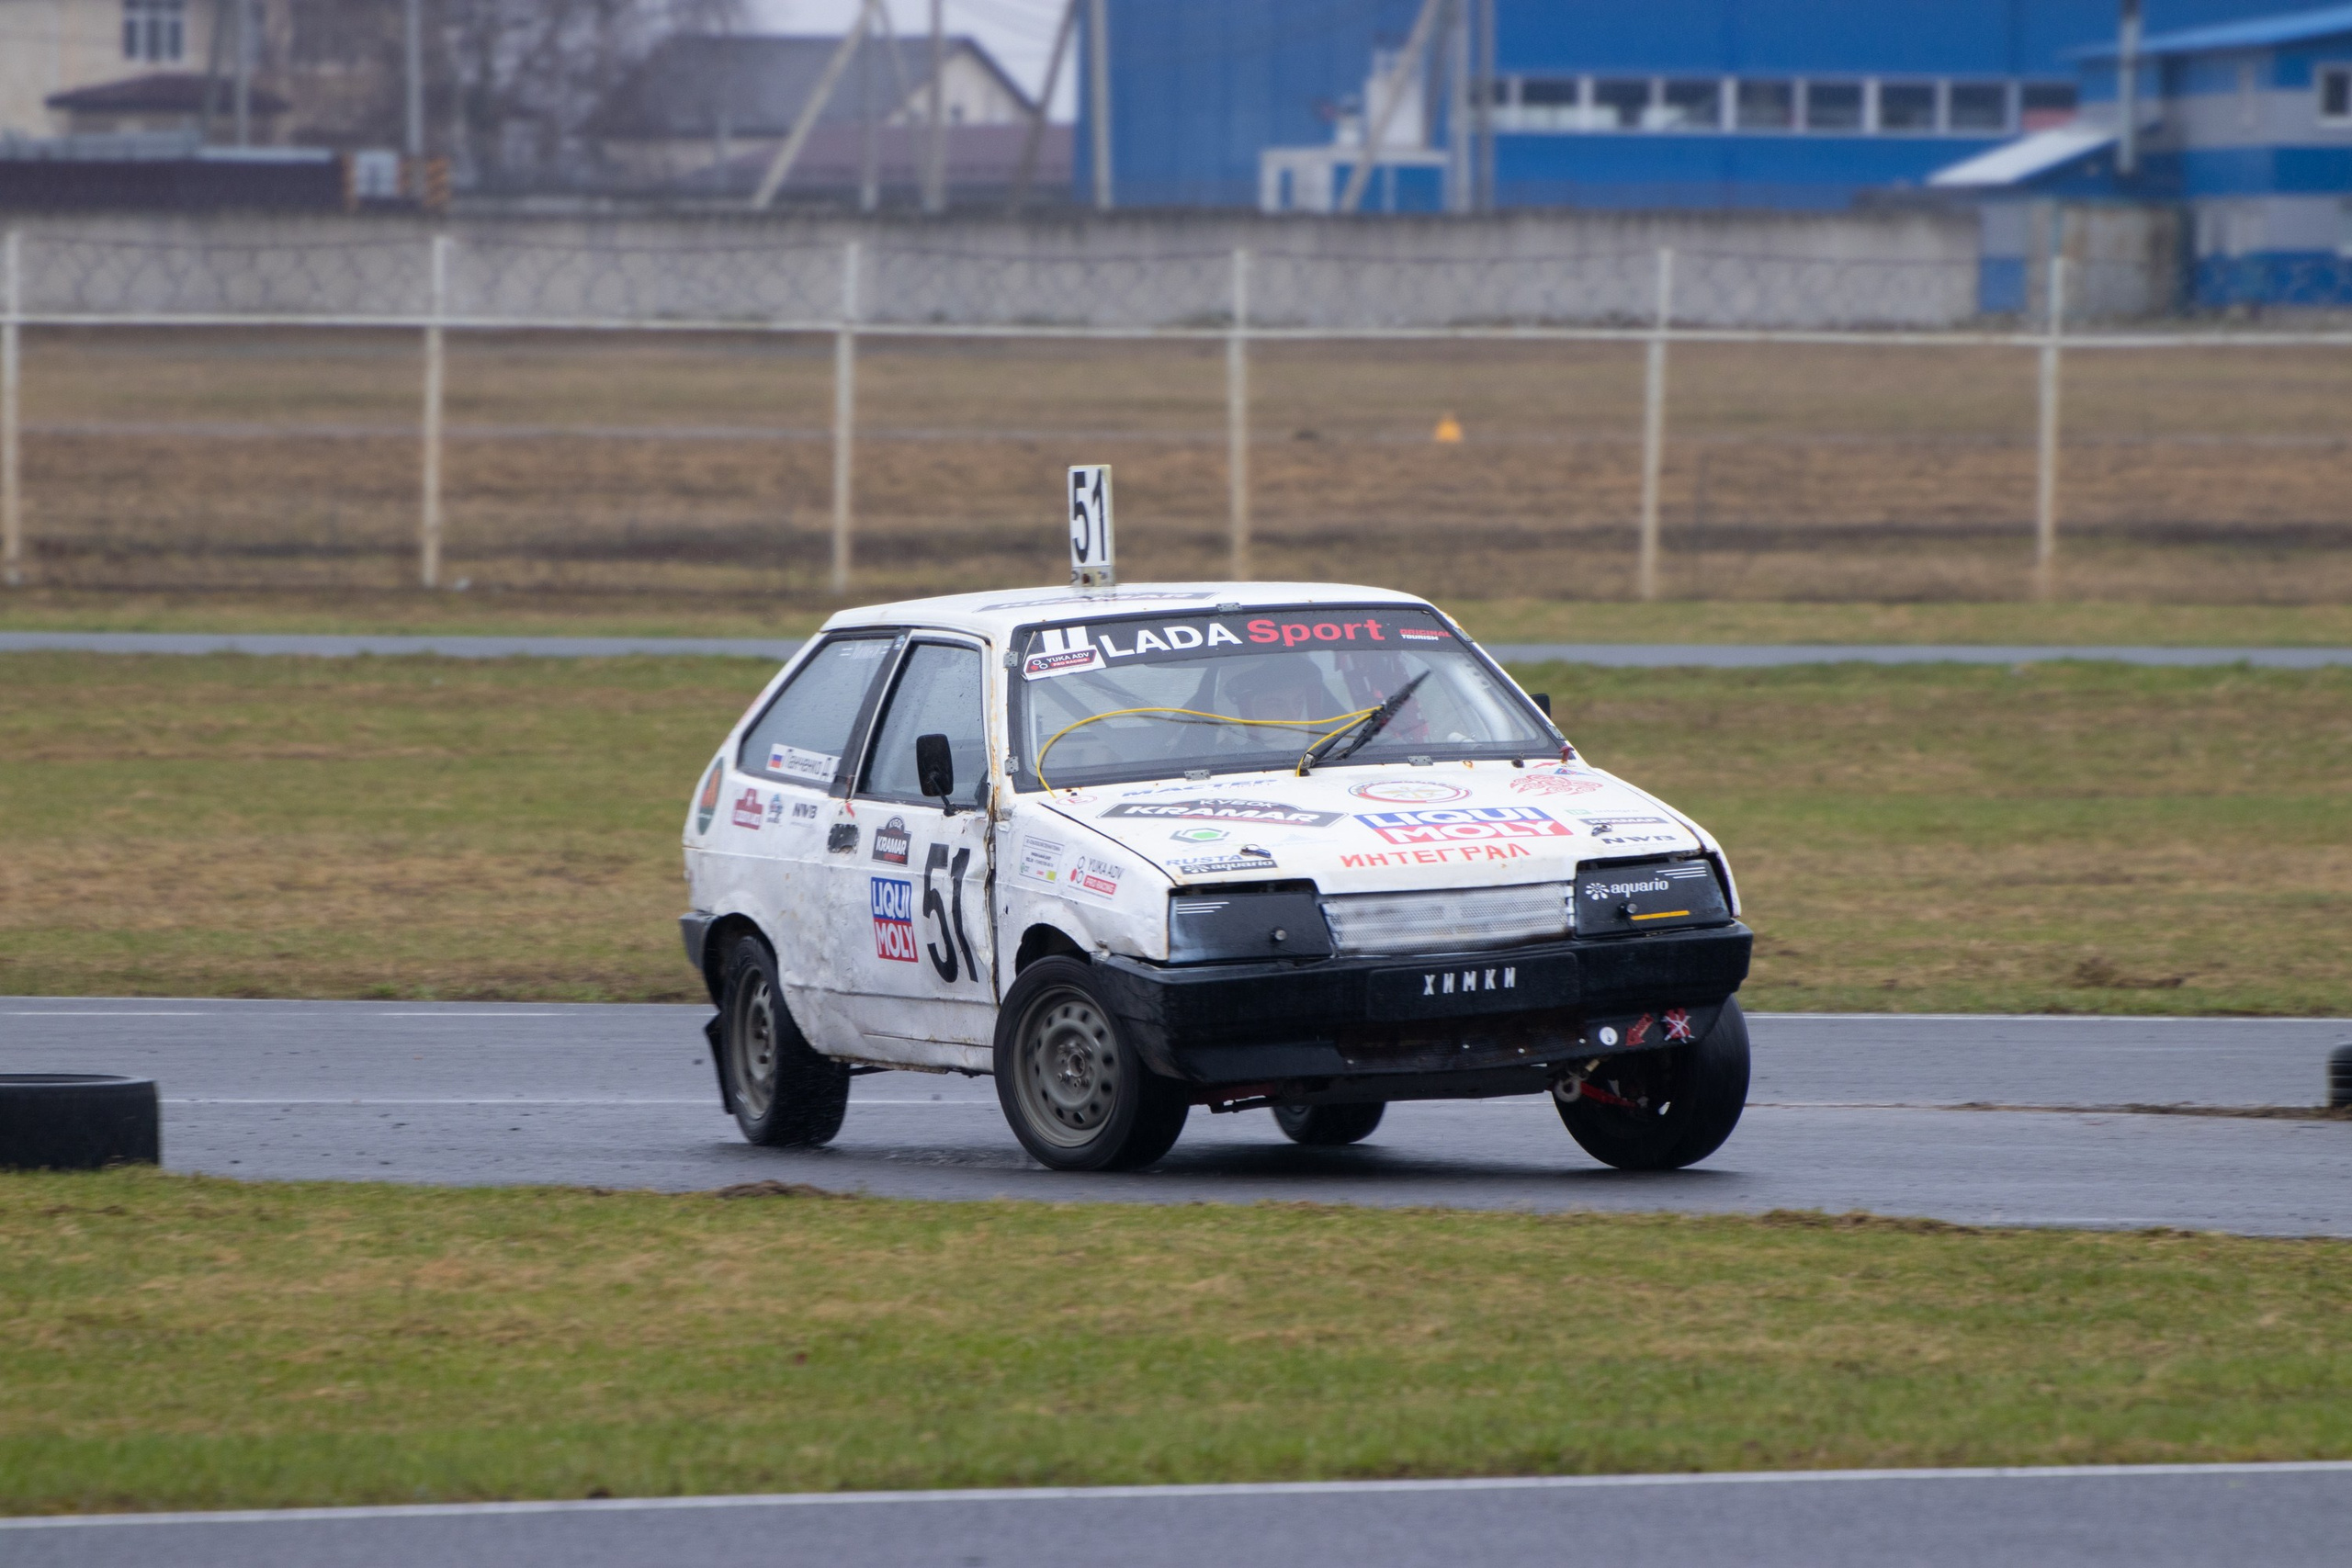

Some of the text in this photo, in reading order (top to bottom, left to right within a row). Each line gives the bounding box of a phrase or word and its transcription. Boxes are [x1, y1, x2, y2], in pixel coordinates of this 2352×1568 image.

[1072, 468, 1106, 564] 51
[1099, 619, 1385, 659] LADA Sport
[1399, 628, 1452, 637] ORIGINAL
[1046, 655, 1072, 663] YUKA
[792, 802, 818, 819] NWB
[1125, 806, 1320, 823] KRAMAR
[1363, 807, 1544, 827] LIQUI
[1384, 820, 1555, 842] MOLY
[1601, 835, 1676, 844] NWB
[876, 835, 907, 855] KRAMAR
[1340, 843, 1531, 868] ИНТЕГРАЛ
[1088, 858, 1125, 879] YUKA ADV
[1211, 859, 1273, 872] aquario
[1611, 877, 1668, 898] aquario
[872, 881, 910, 920] LIQUI
[922, 843, 978, 984] 51
[875, 921, 915, 959] MOLY
[1423, 967, 1516, 996] ХИМКИ
